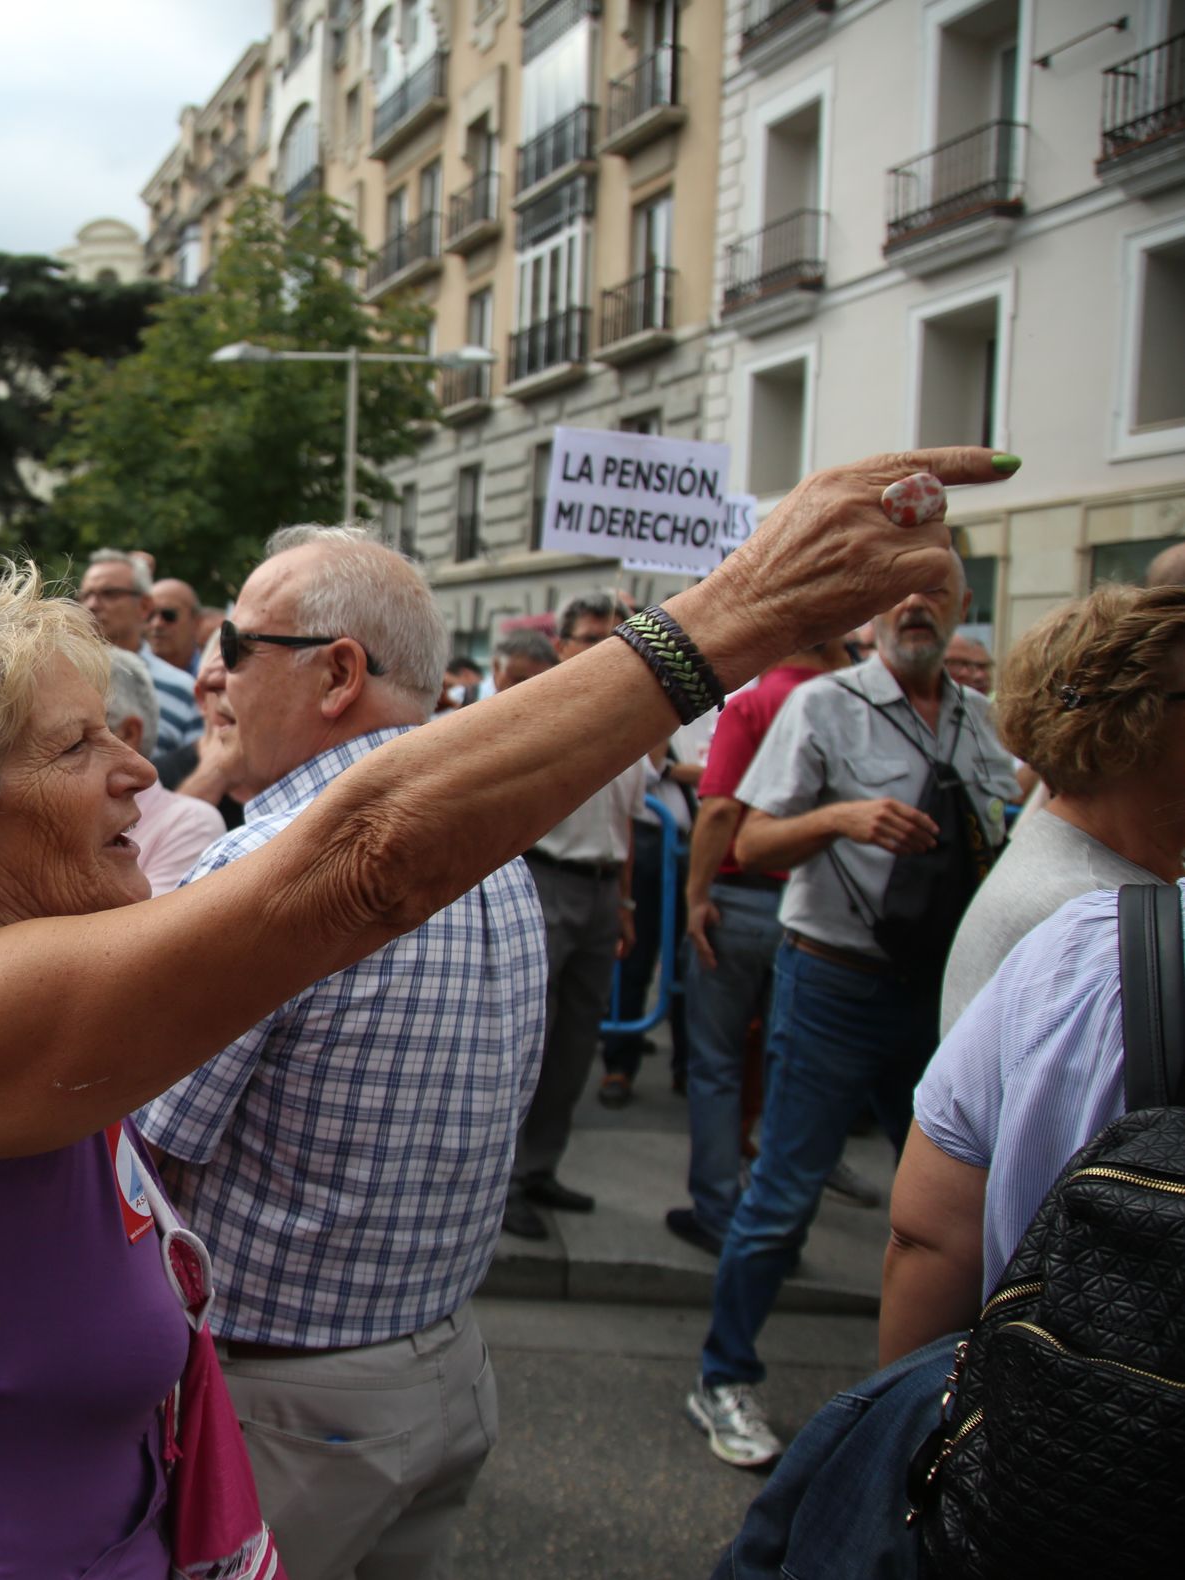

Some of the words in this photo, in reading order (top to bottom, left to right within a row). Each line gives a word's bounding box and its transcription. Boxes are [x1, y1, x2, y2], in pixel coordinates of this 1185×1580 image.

[561, 452, 593, 484] LA
[601, 457, 723, 505] PENSIÓN,
[553, 500, 583, 532] MI
[588, 505, 719, 549] DERECHO!
